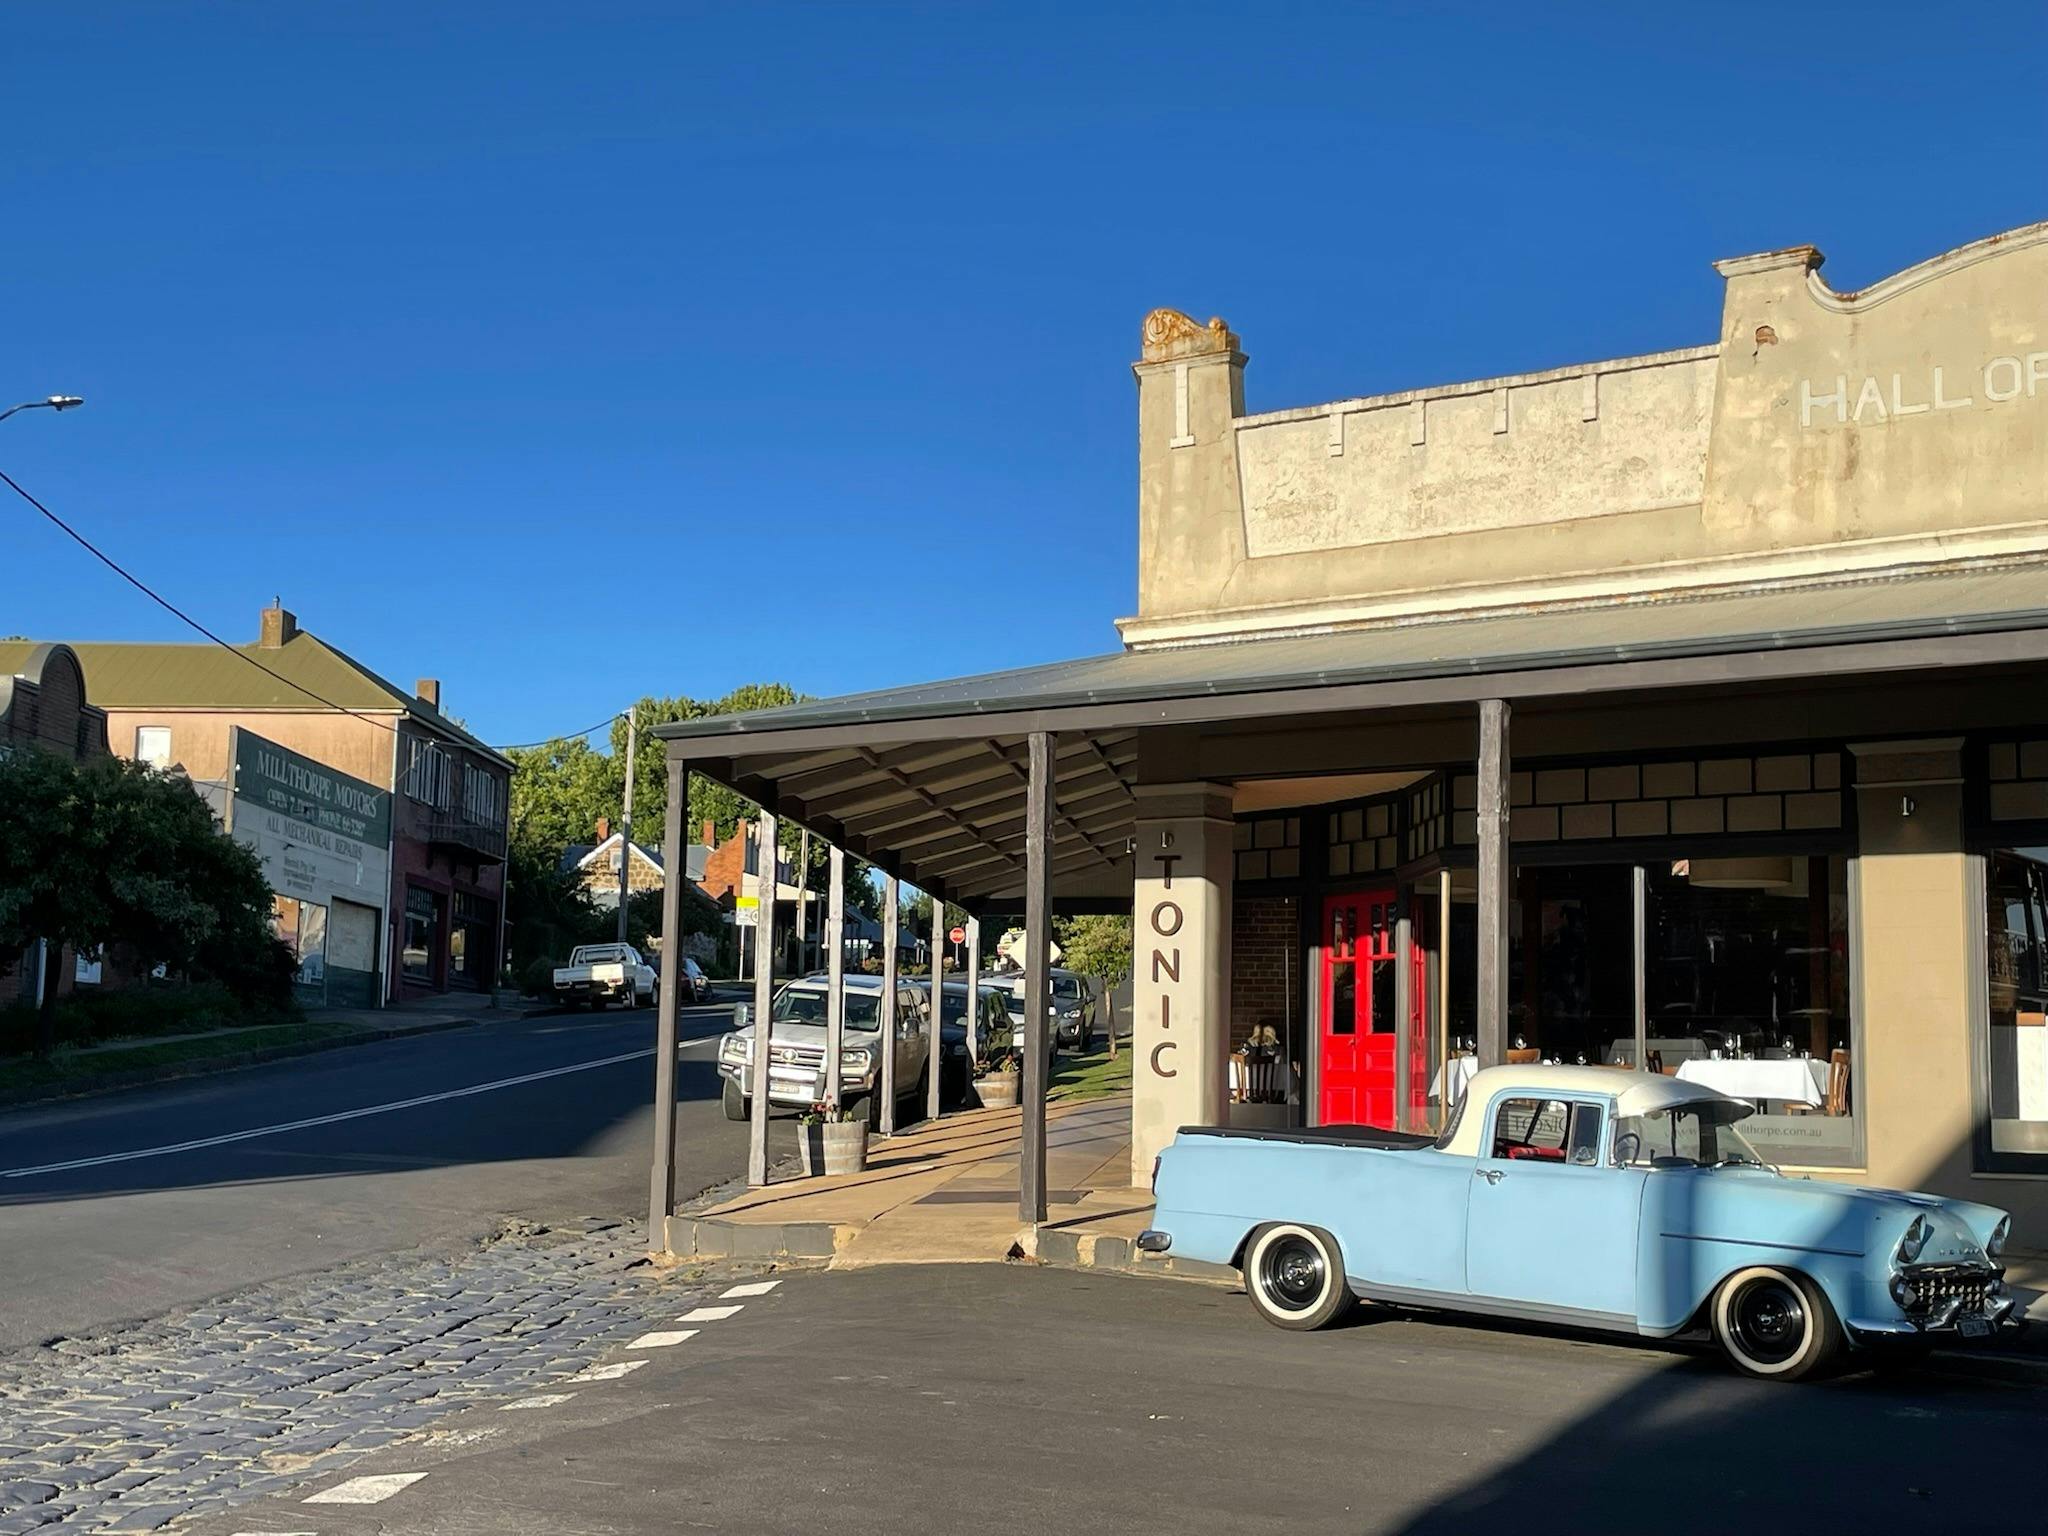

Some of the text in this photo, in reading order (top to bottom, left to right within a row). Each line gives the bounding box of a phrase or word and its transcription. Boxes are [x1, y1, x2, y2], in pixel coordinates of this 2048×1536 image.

[1800, 366, 1973, 428] HALL
[256, 750, 378, 818] MILLTHORPE MOTORS
[265, 815, 281, 834] ALL
[283, 819, 332, 851] MECHANICAL
[1150, 855, 1184, 1078] TONIC
